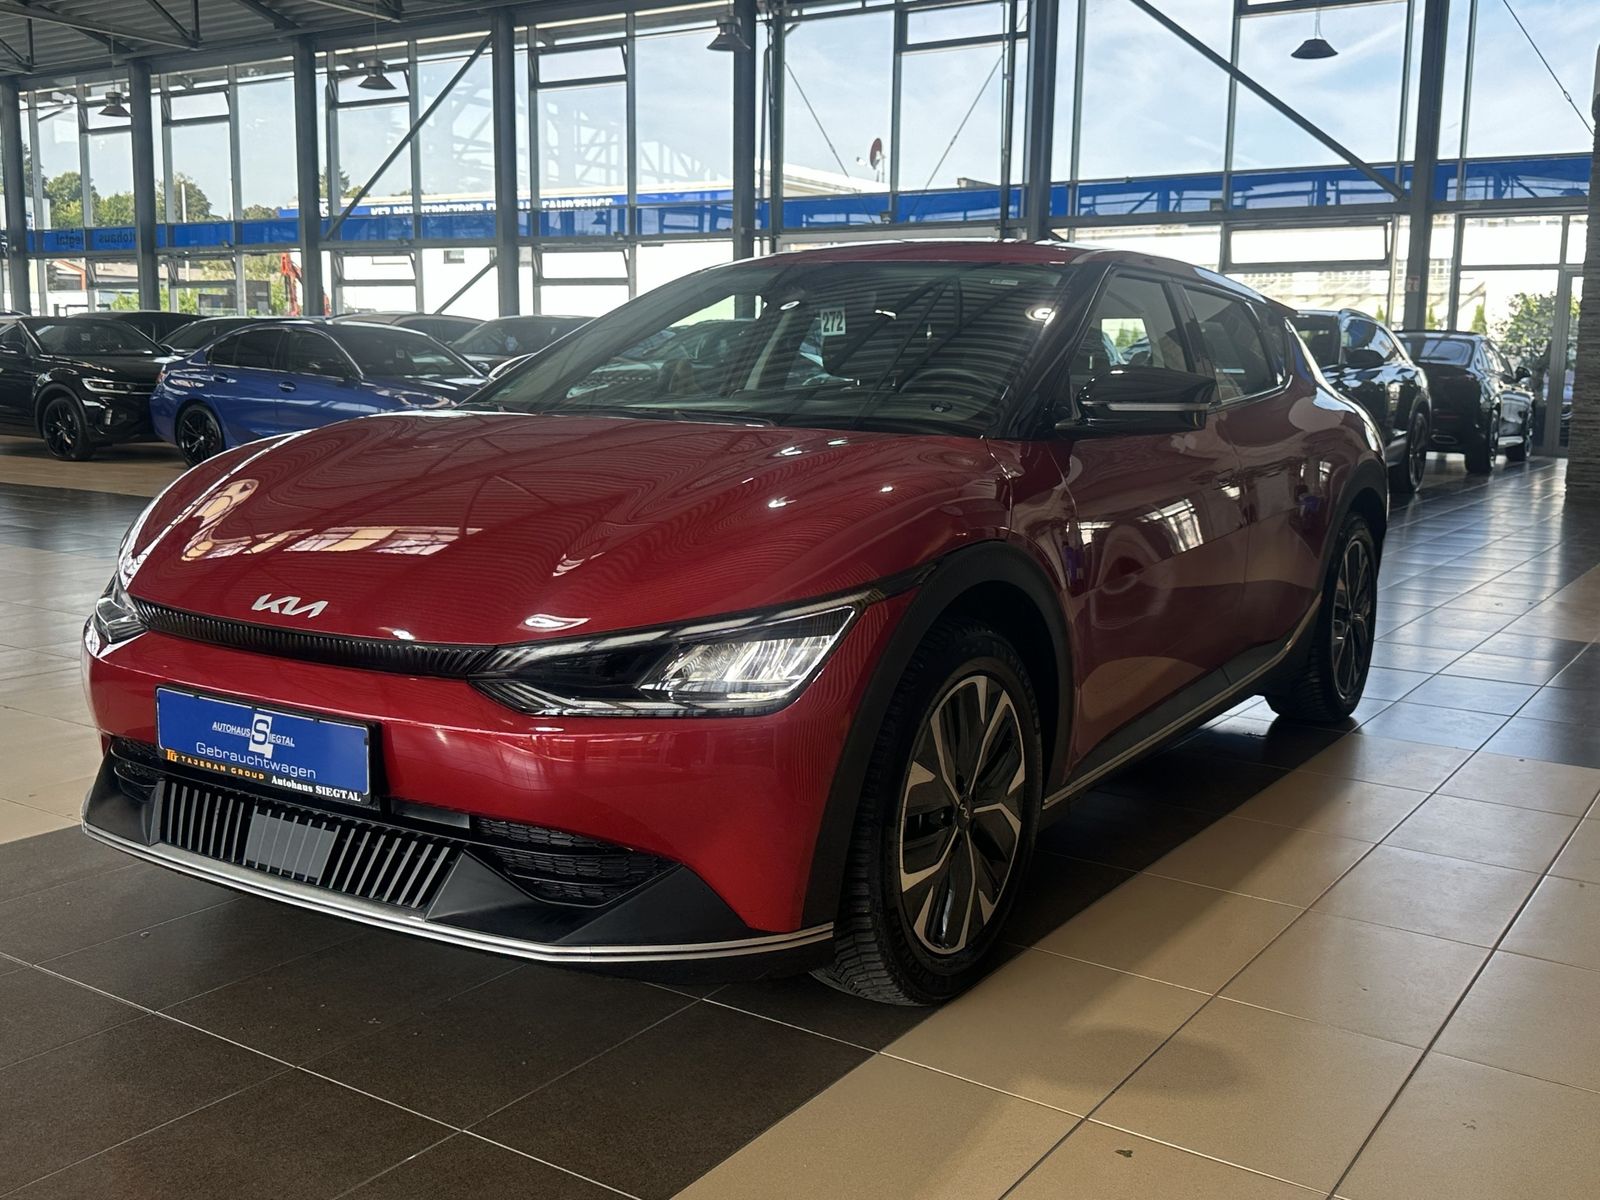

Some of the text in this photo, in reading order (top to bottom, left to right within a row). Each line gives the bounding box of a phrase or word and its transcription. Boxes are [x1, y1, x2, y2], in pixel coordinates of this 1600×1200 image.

[822, 311, 844, 332] 272
[251, 593, 329, 619] KIA
[211, 721, 251, 738] AUTOHAUS
[196, 741, 317, 780] Gebrauchtwagen
[181, 755, 226, 772] TAJERAN
[230, 767, 265, 780] GROUP
[271, 775, 313, 793] Autohaus
[315, 785, 362, 802] SIEGTAL
